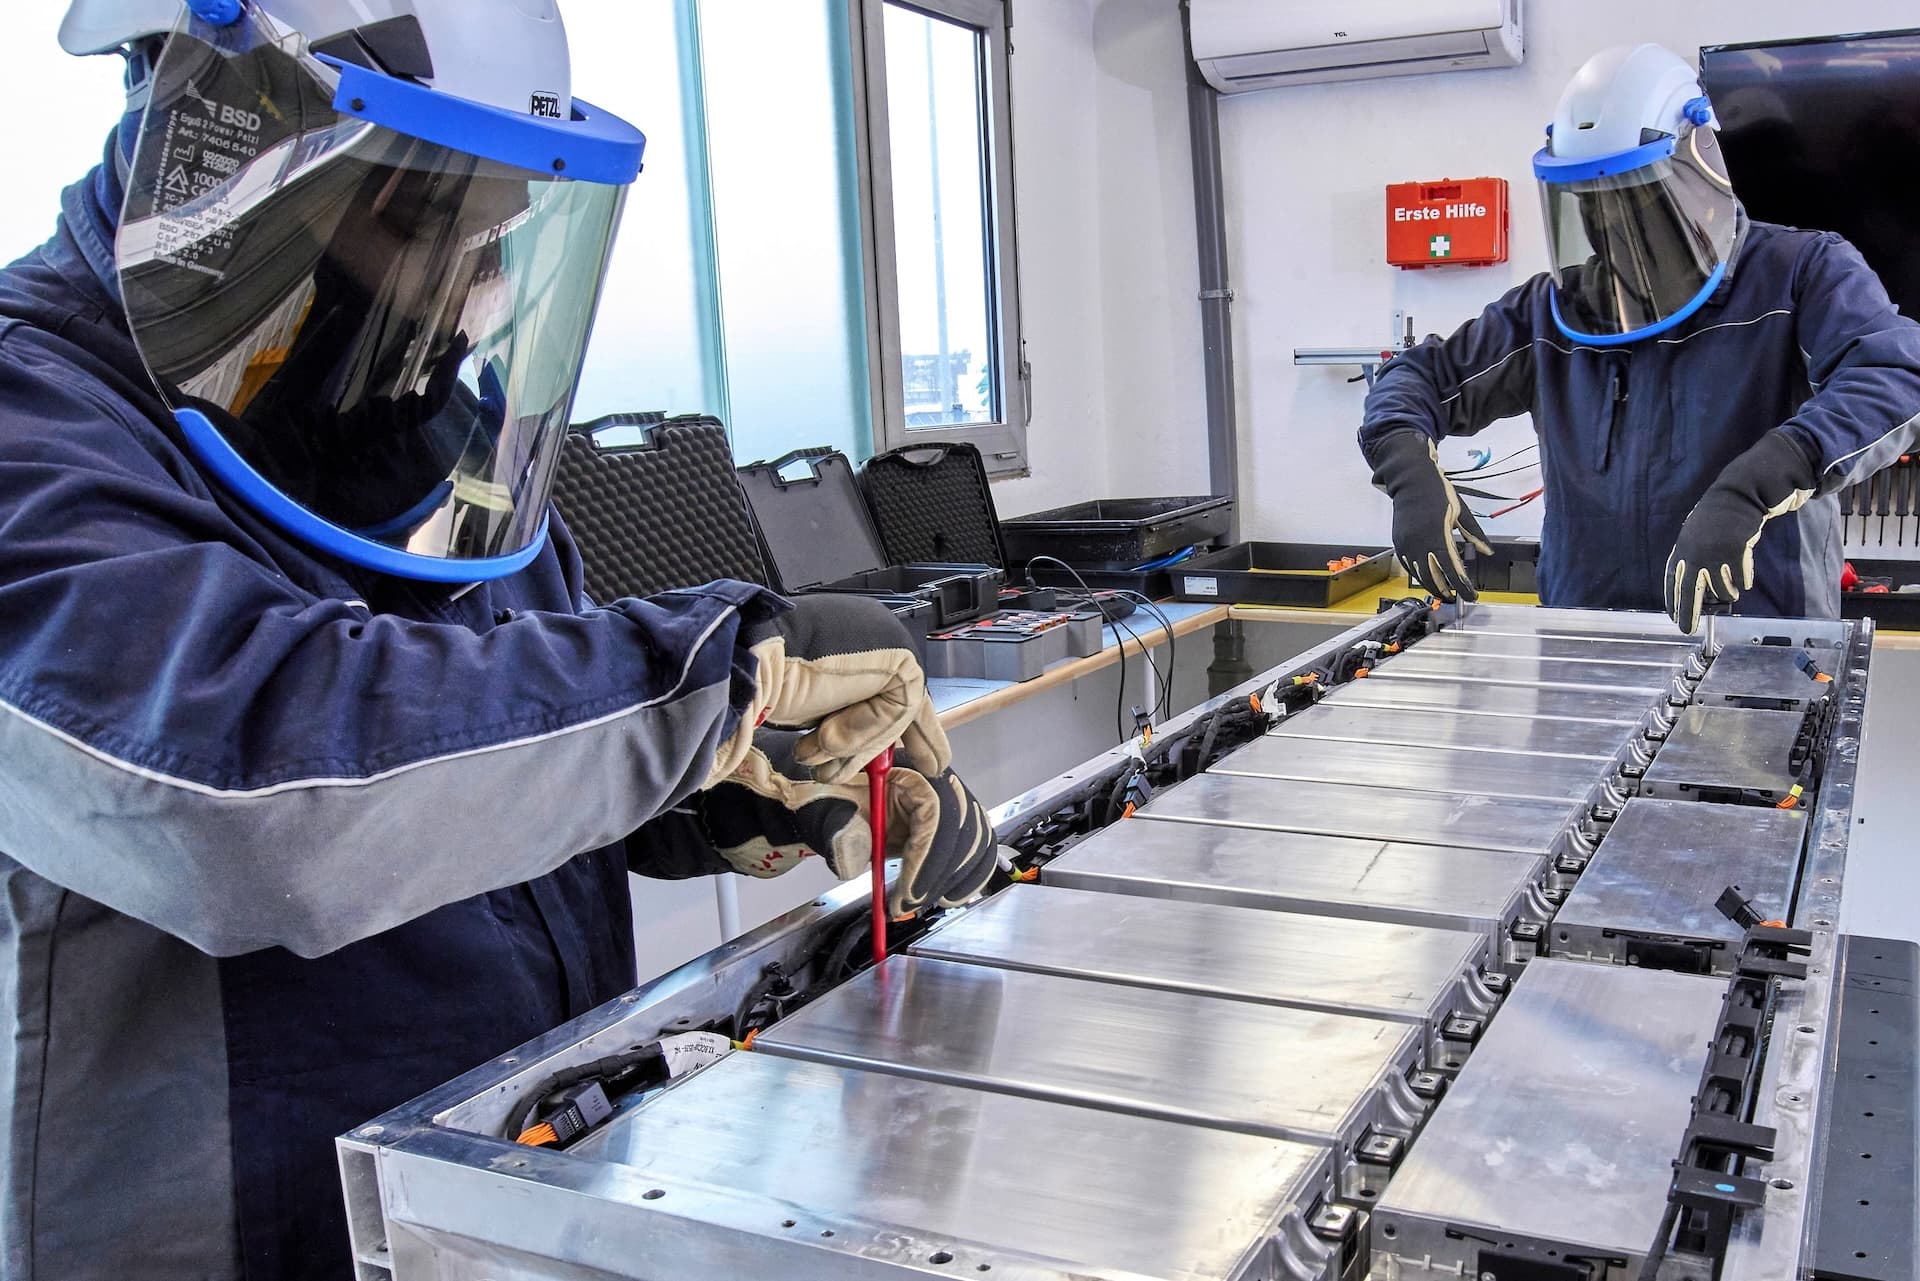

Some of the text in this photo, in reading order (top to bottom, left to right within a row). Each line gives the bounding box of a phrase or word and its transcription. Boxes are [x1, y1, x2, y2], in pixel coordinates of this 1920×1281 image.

[220, 104, 261, 131] BSD
[531, 95, 561, 118] PETZL
[1394, 202, 1487, 222] Erste Hilfe
